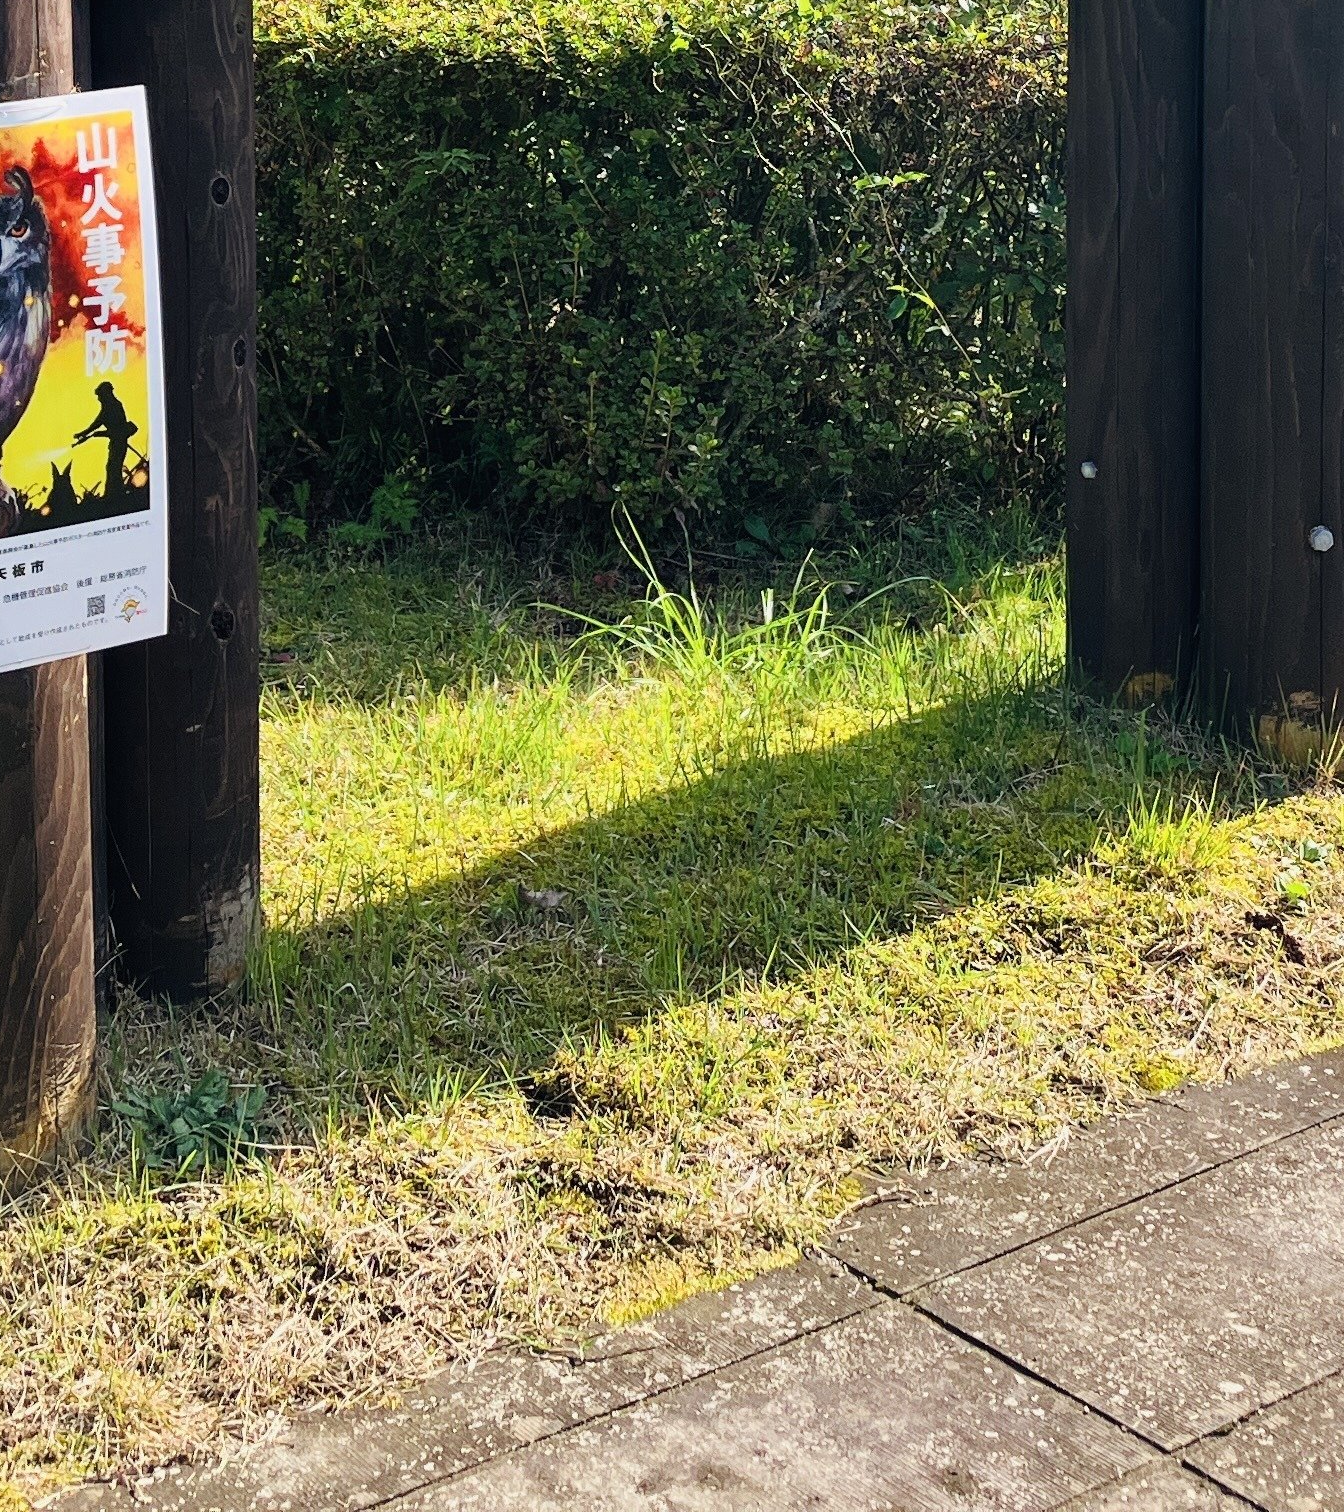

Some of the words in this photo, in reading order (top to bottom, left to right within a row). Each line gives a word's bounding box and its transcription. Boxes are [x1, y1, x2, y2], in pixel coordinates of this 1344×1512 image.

[75, 122, 128, 378] 山火事予防
